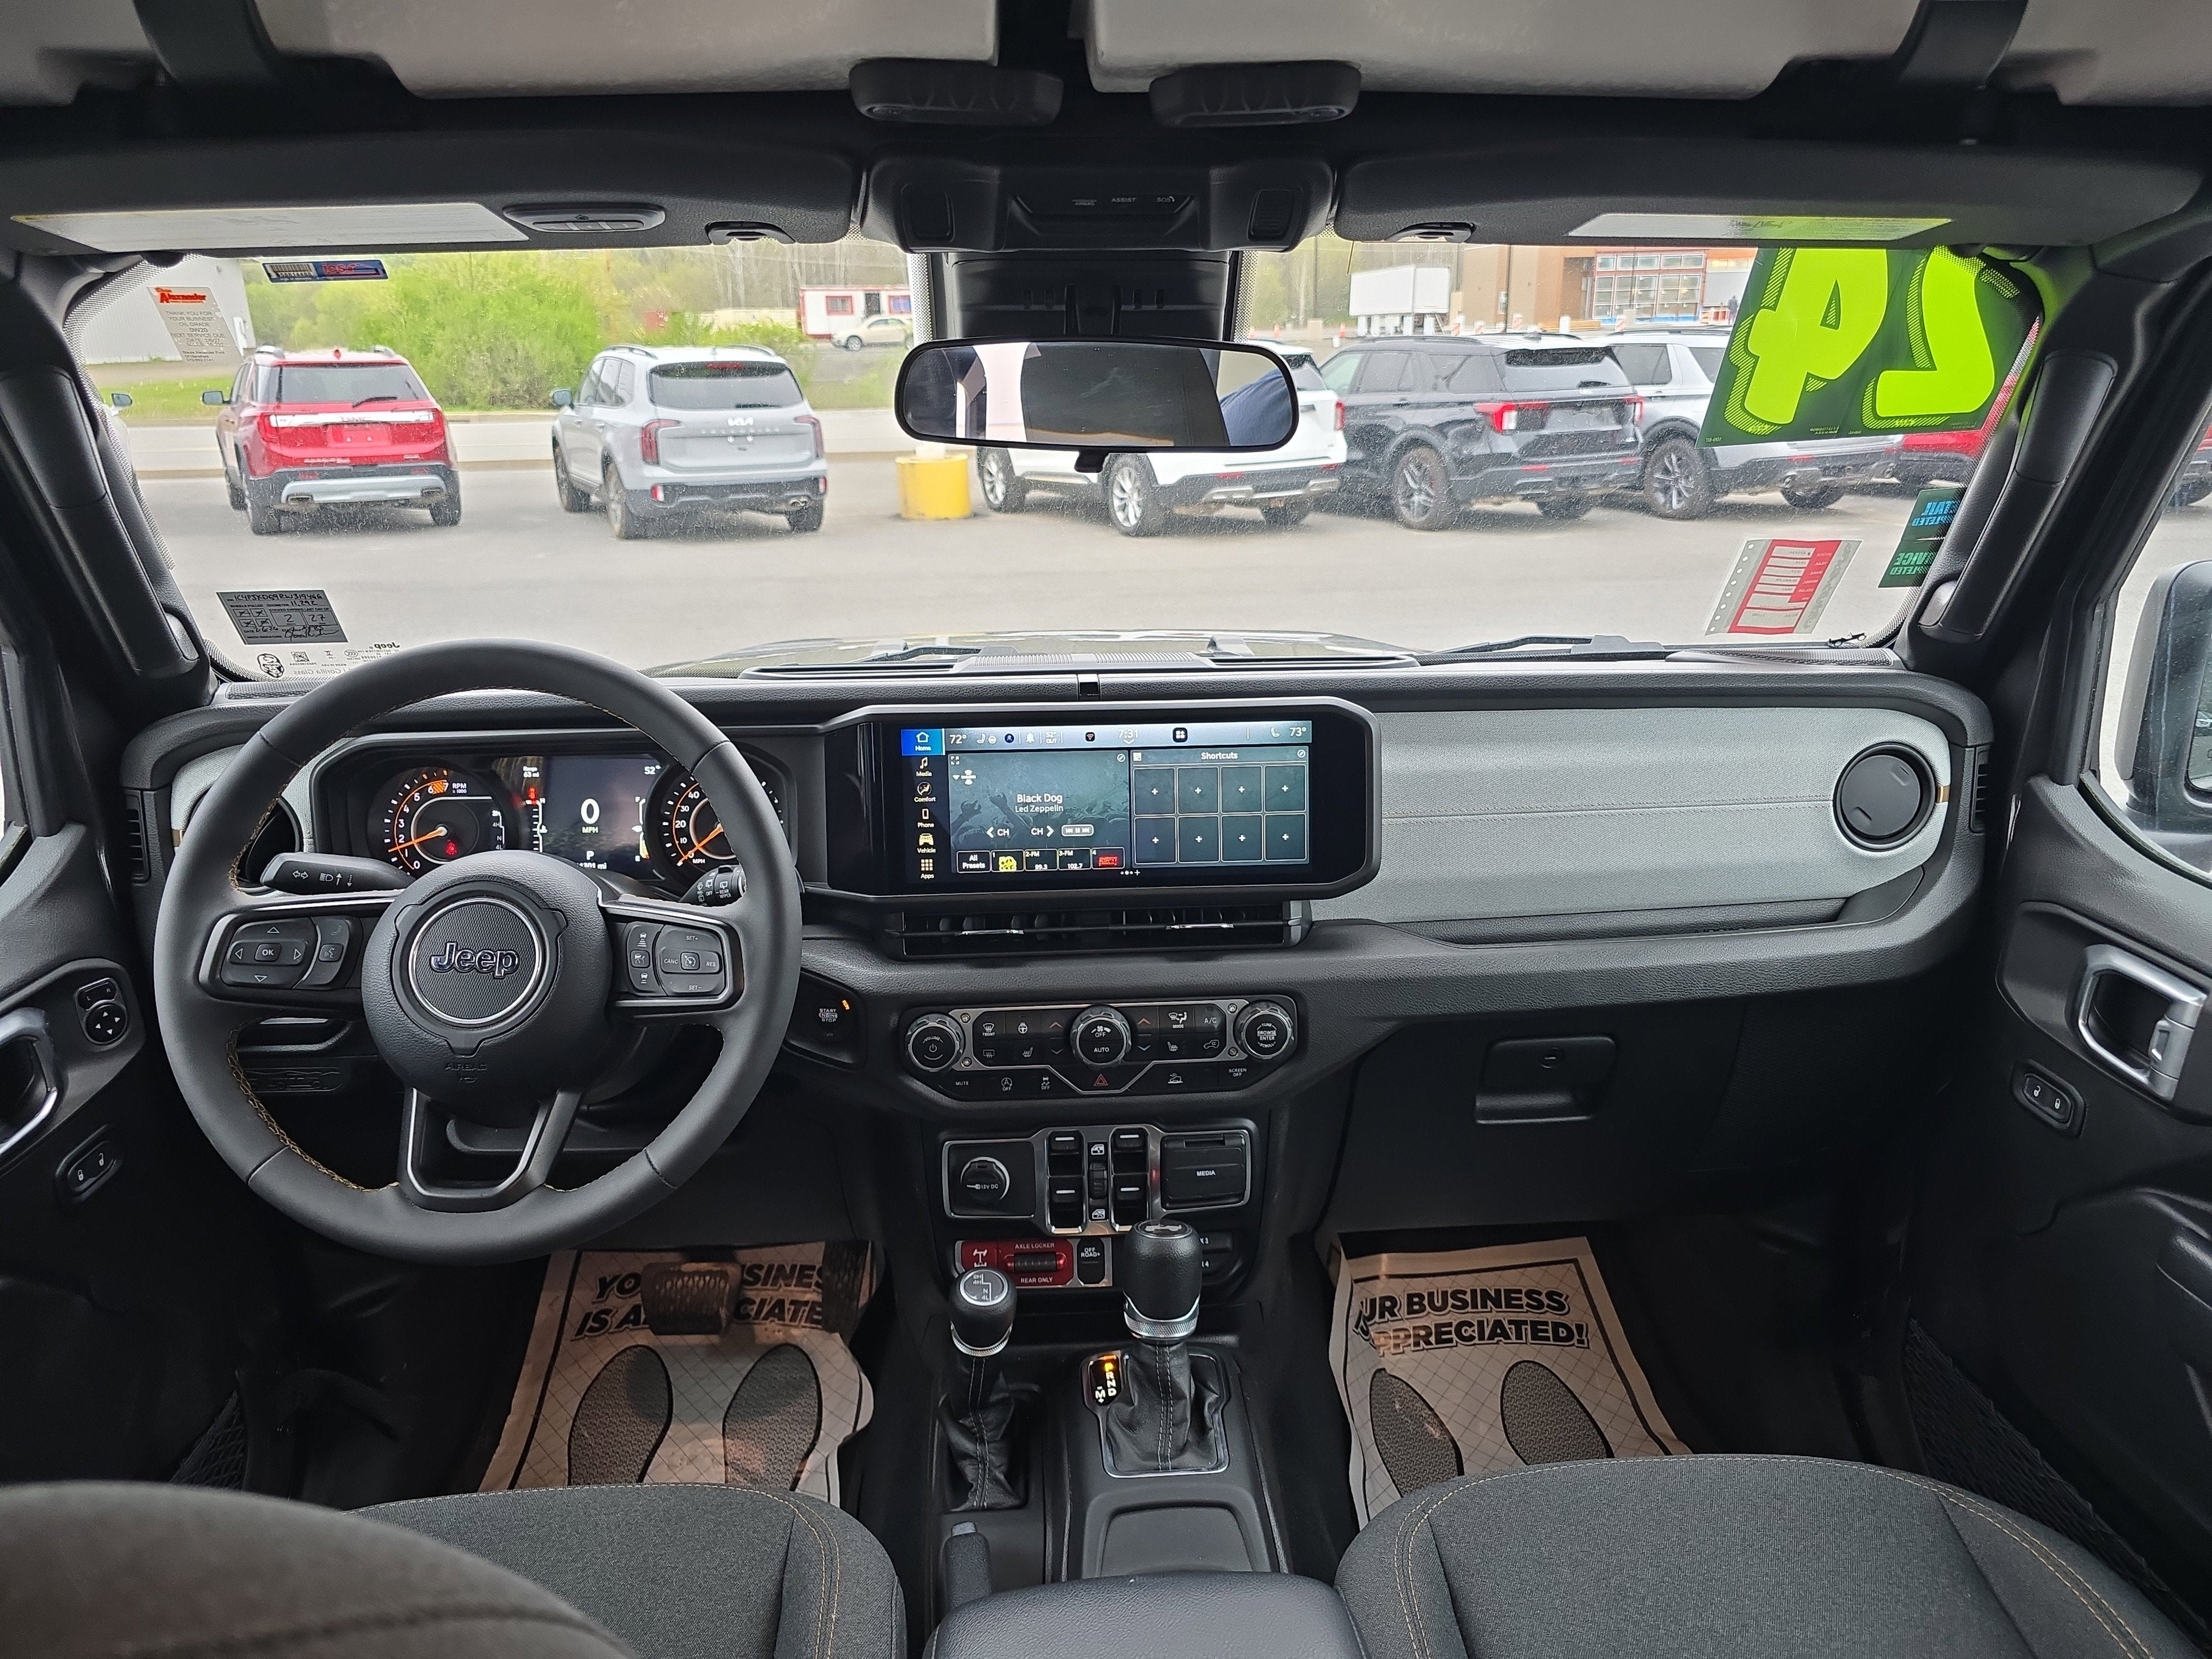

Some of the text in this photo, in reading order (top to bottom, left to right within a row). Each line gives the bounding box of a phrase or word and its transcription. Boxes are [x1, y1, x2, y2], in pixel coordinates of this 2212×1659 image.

[284, 614, 294, 622] 2
[308, 614, 326, 622] 27
[1118, 729, 1139, 738] 7:31
[1201, 751, 1238, 760] Shortcuts
[428, 786, 434, 794] 6
[443, 782, 449, 792] 7
[414, 793, 420, 801] 5
[687, 791, 700, 799] 40
[1017, 793, 1063, 804] Black Dog
[403, 805, 410, 813] 4
[581, 798, 600, 824] 0
[1030, 805, 1064, 814] Zeppelin
[398, 819, 404, 828] 3
[674, 820, 686, 828] 20
[997, 828, 1009, 837] CH
[1031, 827, 1044, 836] CH
[398, 834, 405, 843] 2
[586, 850, 594, 860] P
[413, 860, 420, 869] 0
[962, 861, 986, 870] Presets
[430, 942, 518, 976] Jeep
[1204, 1017, 1217, 1025] A/C
[1406, 1287, 1571, 1316] BUSINESS
[570, 1308, 609, 1341] IS
[1372, 1319, 1590, 1356] PPRECIATED!
[1104, 1362, 1113, 1372] P
[1107, 1379, 1116, 1387] N
[1095, 1390, 1106, 1399] M
[1108, 1388, 1117, 1397] D
